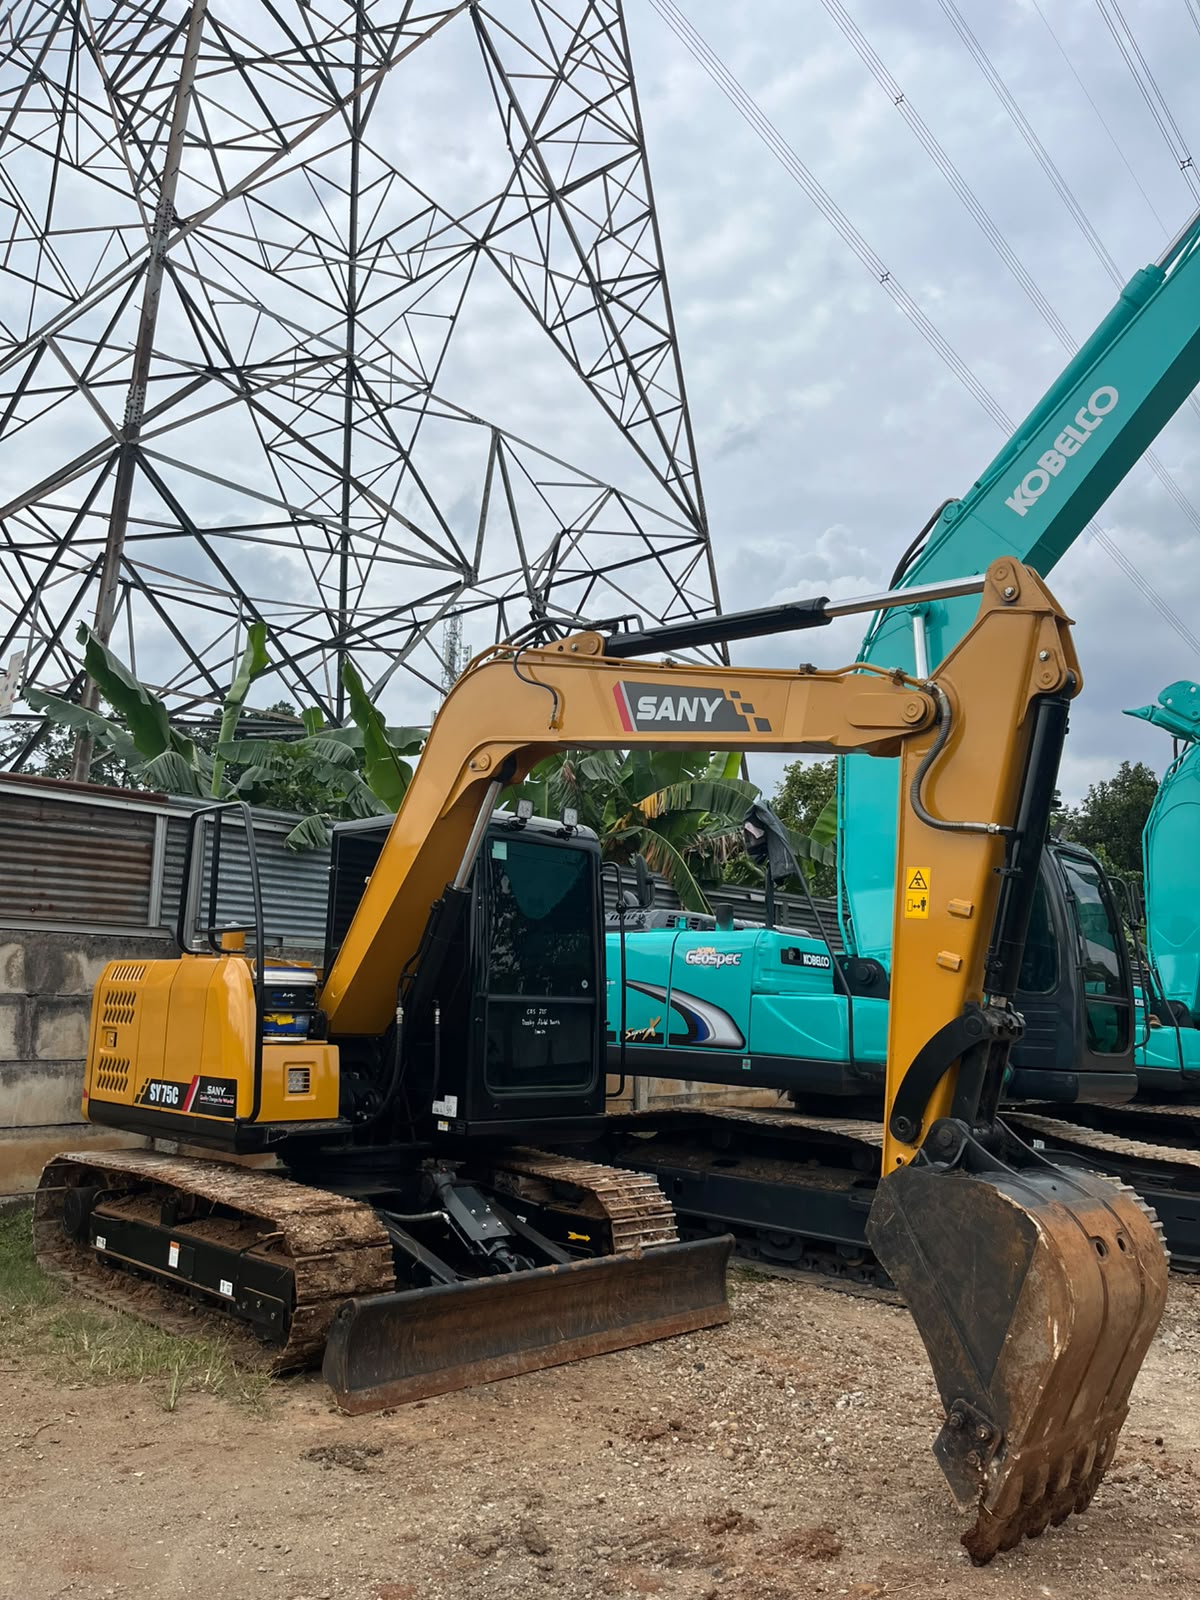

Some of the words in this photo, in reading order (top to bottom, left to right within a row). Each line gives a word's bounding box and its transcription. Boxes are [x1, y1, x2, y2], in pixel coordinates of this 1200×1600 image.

[1004, 385, 1119, 517] KOBELCO
[636, 696, 723, 722] SANY
[685, 949, 742, 969] Geospec
[803, 953, 830, 967] KOBELCO
[207, 1085, 226, 1096] SANY
